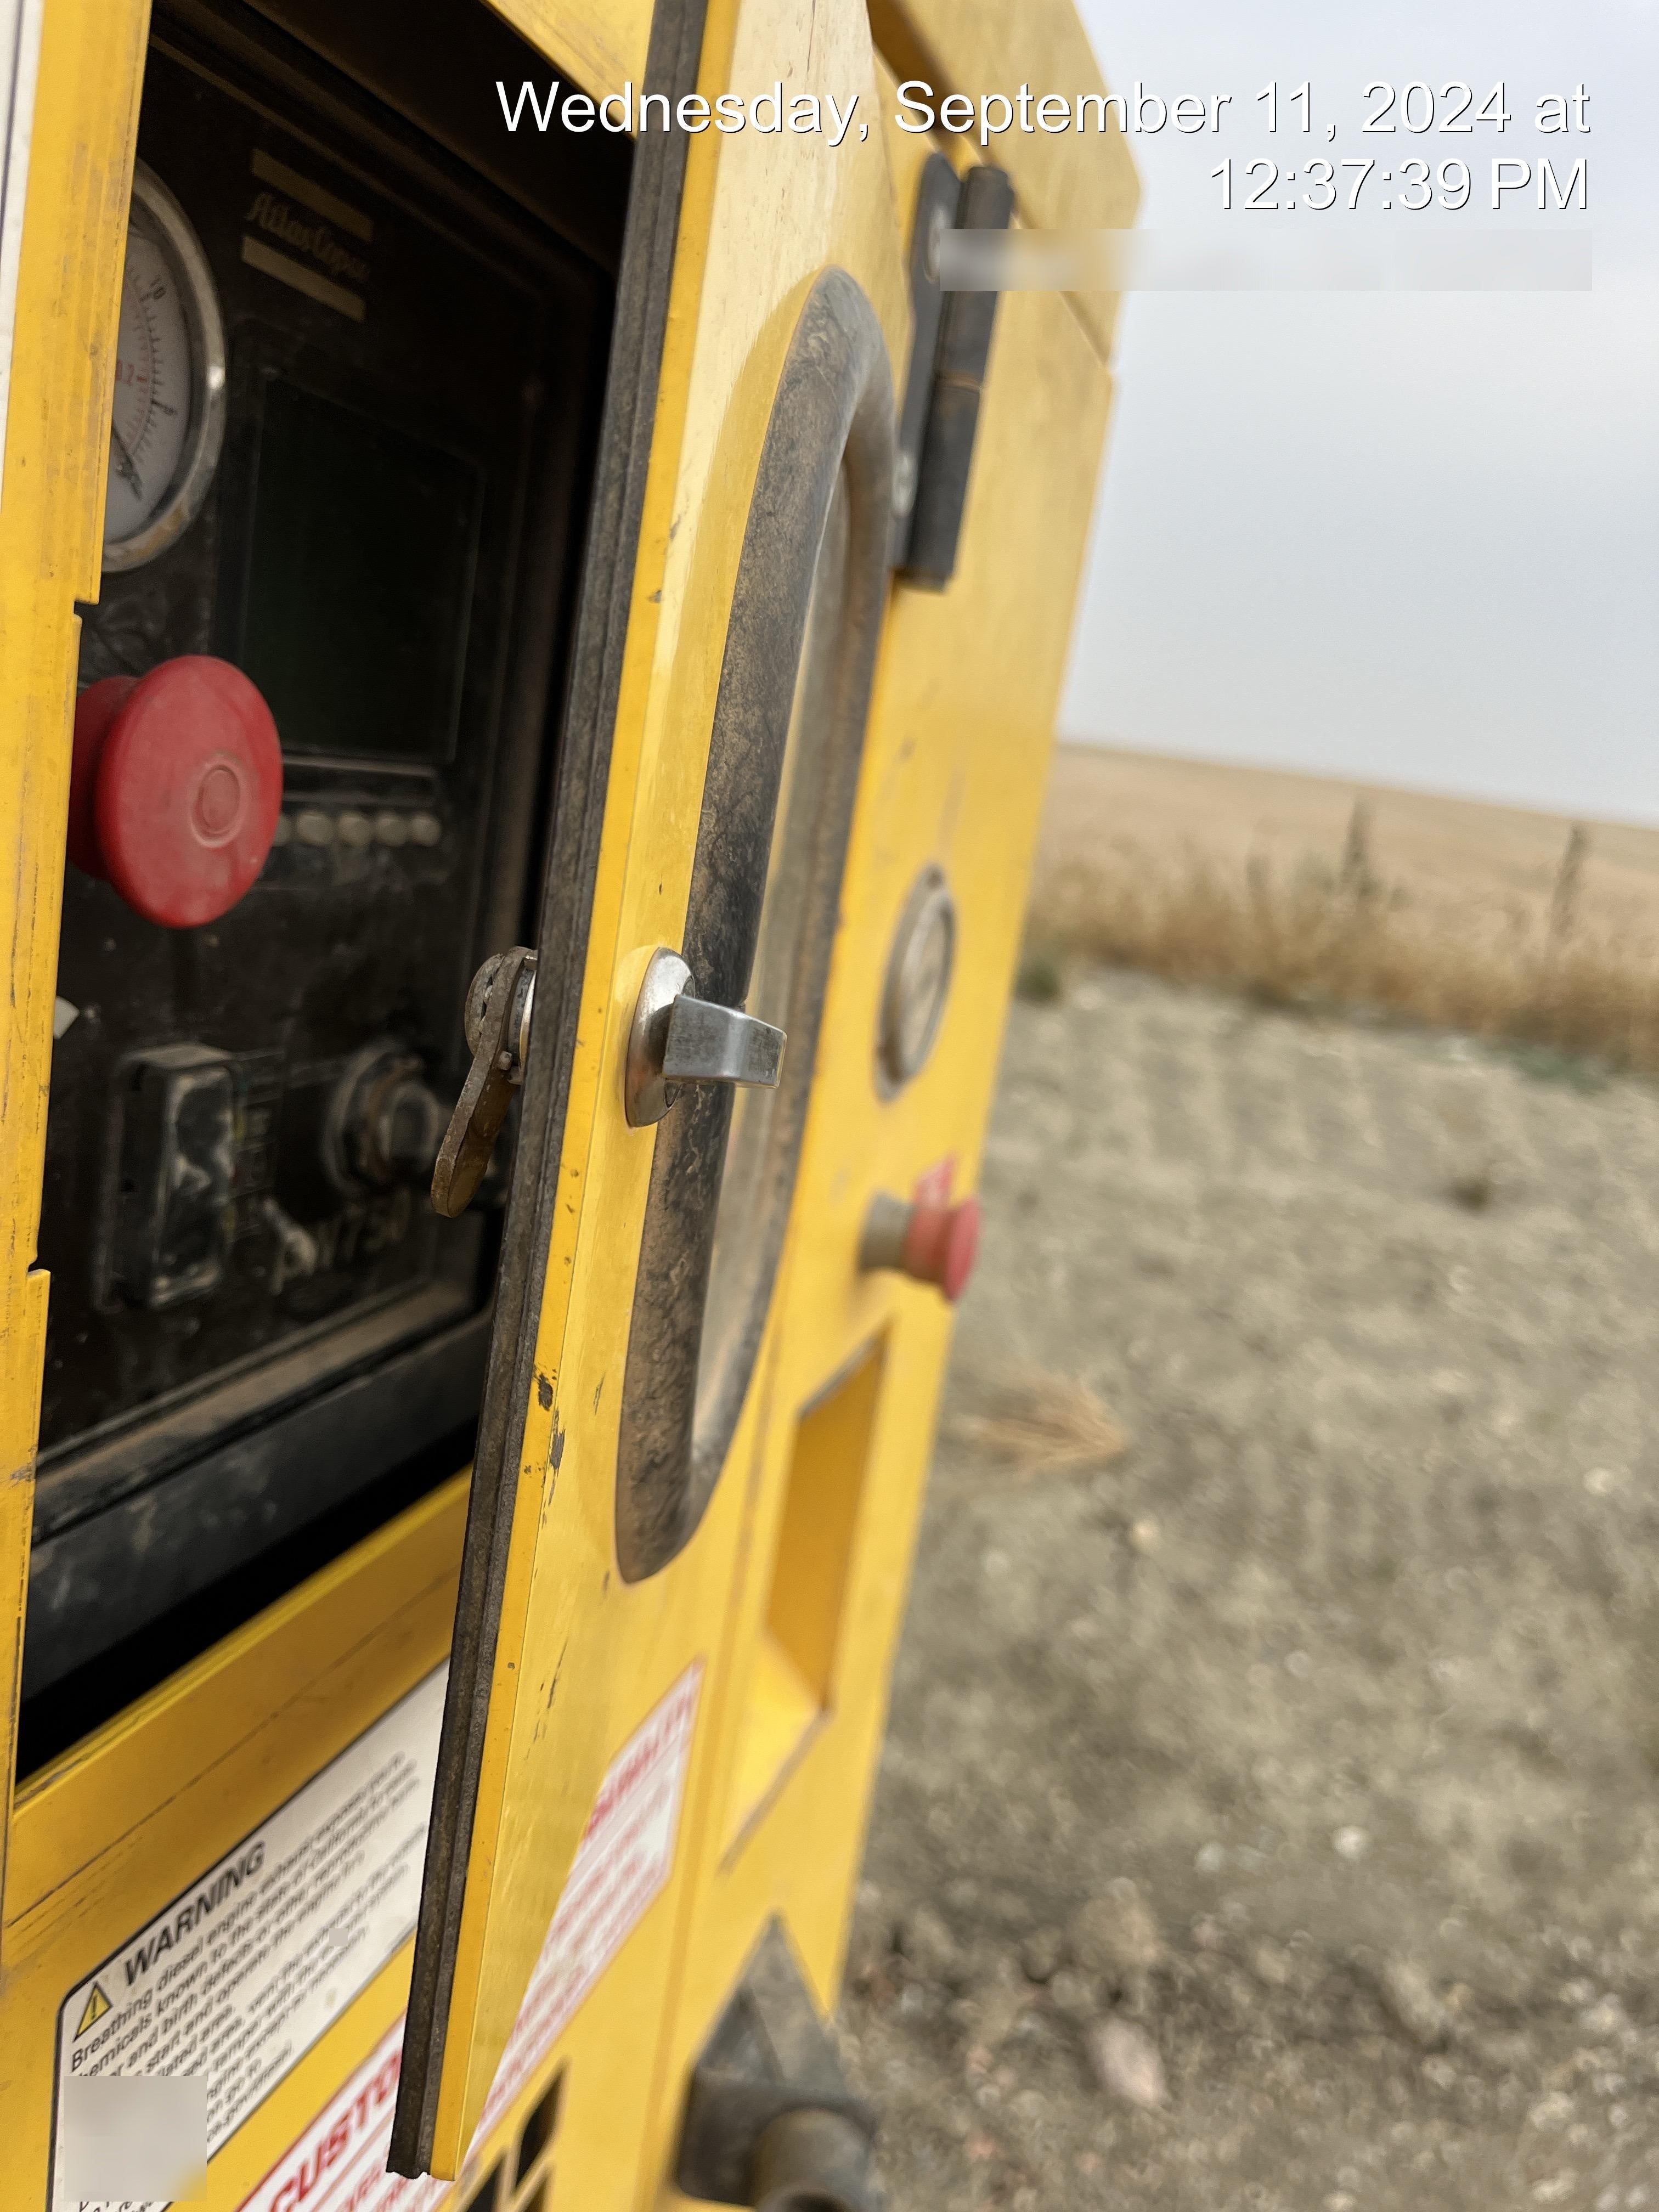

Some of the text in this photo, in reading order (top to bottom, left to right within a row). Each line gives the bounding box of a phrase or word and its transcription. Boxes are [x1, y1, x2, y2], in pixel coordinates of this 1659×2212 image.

[125, 1842, 263, 1984] WARNING
[71, 1989, 152, 2071] Breathing
[157, 1937, 203, 1991] diesel
[206, 1892, 257, 1944] engine
[80, 2013, 151, 2076] emicals
[156, 1961, 207, 2016] known
[127, 2026, 158, 2068] and
[162, 1994, 197, 2034] birth
[183, 1996, 212, 2035] and
